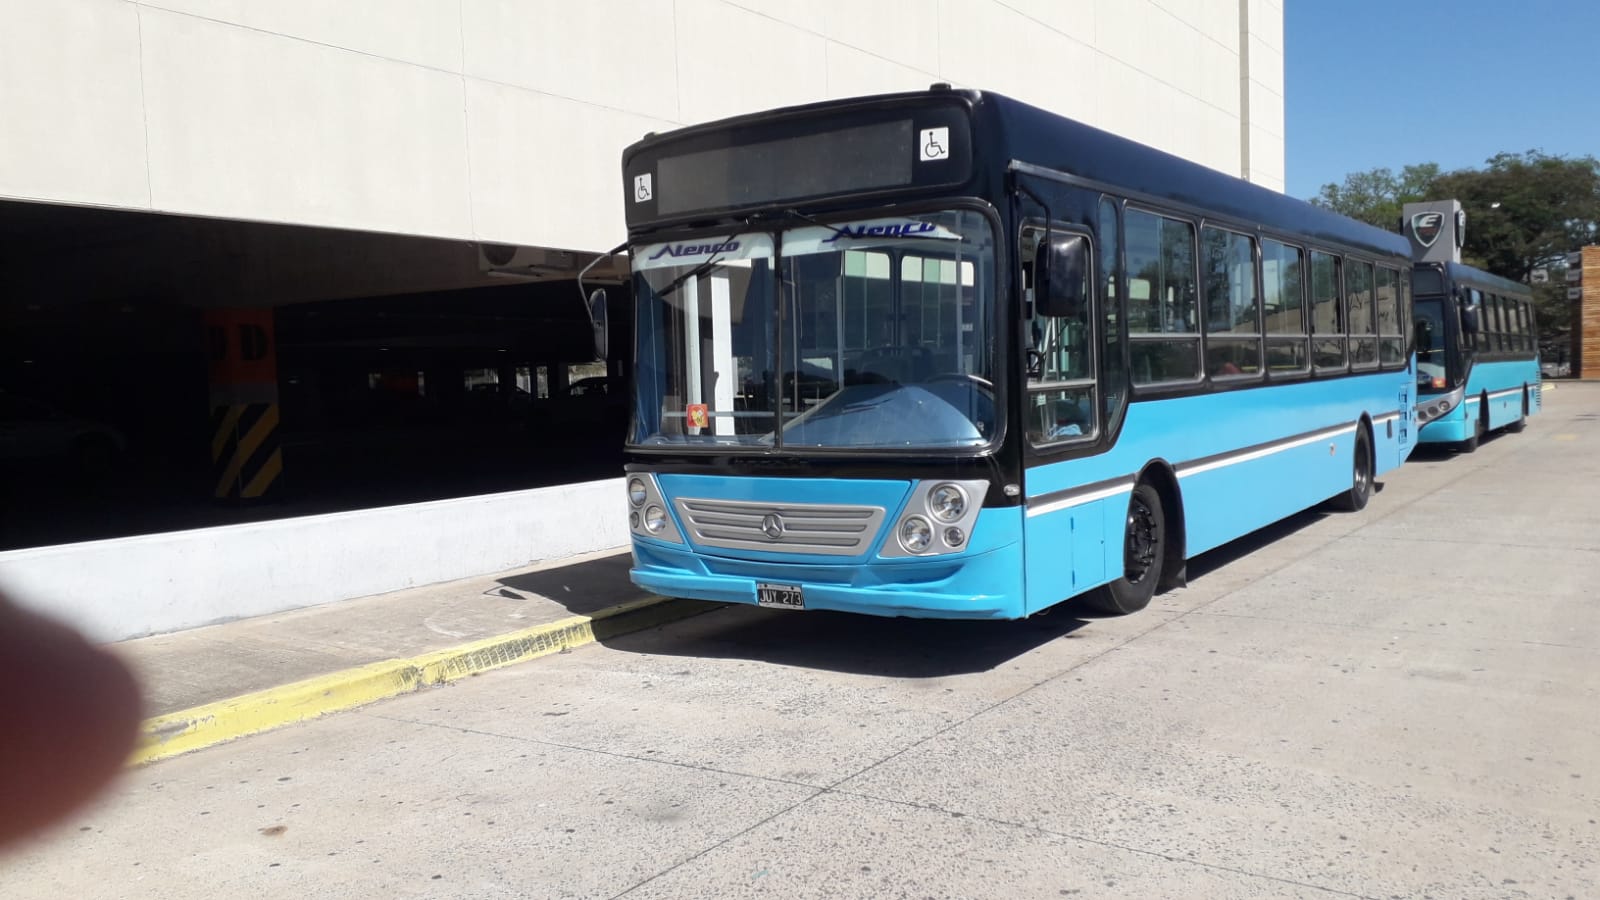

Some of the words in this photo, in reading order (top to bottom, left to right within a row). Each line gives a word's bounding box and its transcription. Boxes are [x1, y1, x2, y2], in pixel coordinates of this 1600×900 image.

[822, 221, 936, 243] Alenco
[649, 241, 740, 260] Alenco
[760, 589, 777, 603] JUY
[782, 591, 802, 605] 273
